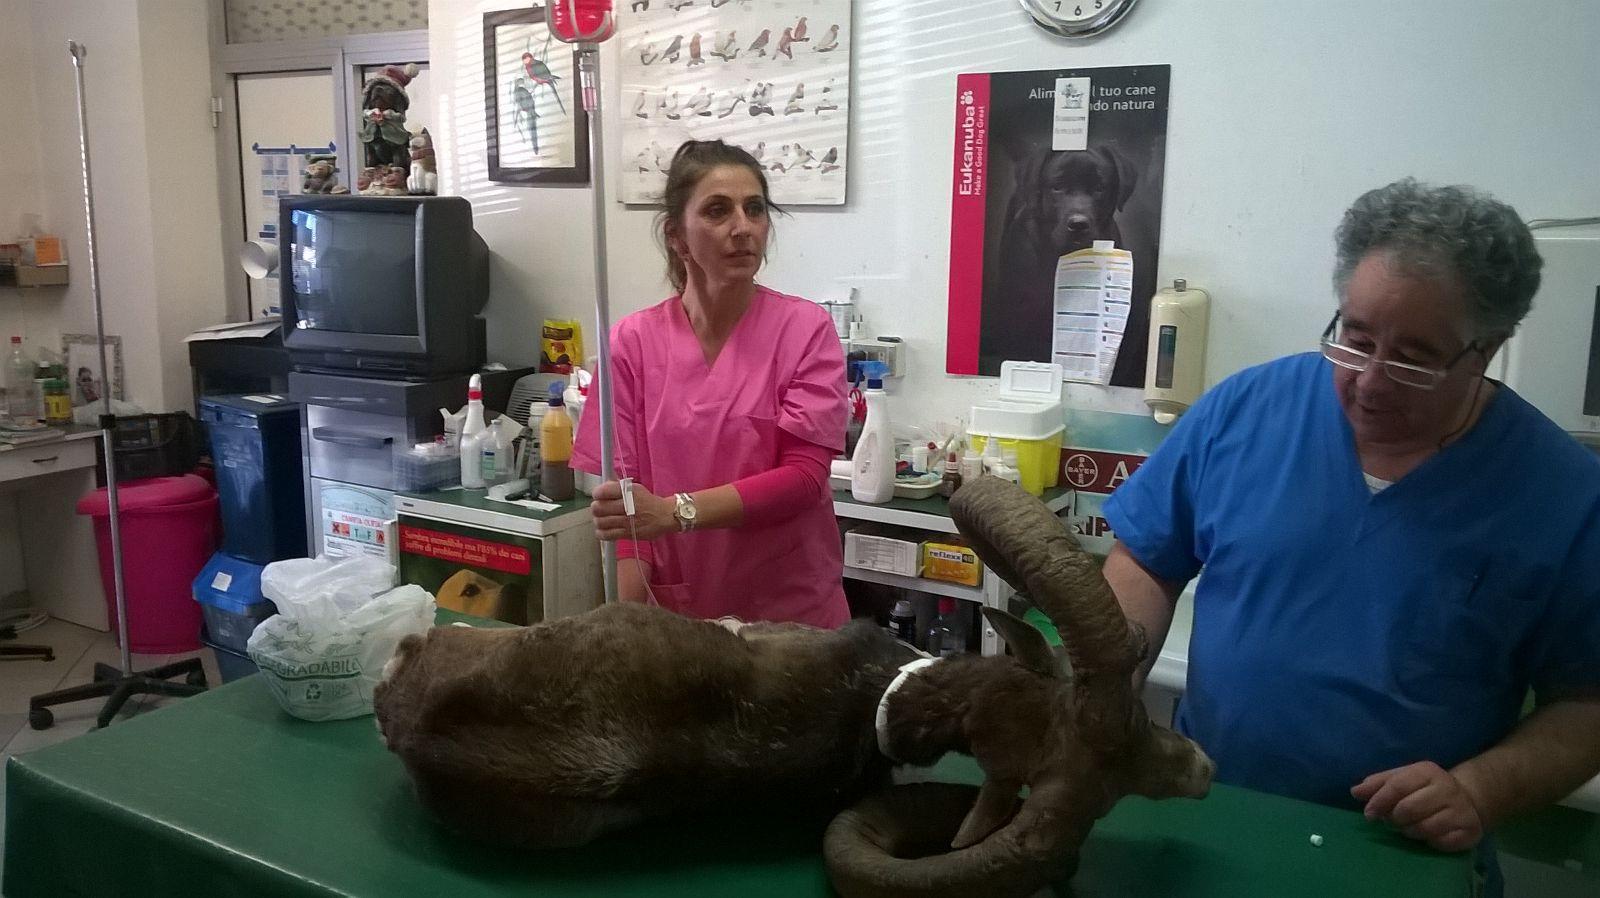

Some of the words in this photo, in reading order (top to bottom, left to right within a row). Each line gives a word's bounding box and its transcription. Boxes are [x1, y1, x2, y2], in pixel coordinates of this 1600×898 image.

[1054, 1, 1061, 12] 7
[1074, 5, 1082, 16] 6
[1094, 0, 1103, 9] 5
[1100, 86, 1122, 97] tuo
[1125, 85, 1157, 96] cane
[1112, 99, 1155, 111] natura
[976, 106, 986, 128] Great
[975, 130, 986, 145] Dog
[960, 106, 975, 195] Eukanuba
[975, 146, 984, 168] Good
[974, 175, 983, 196] Make
[1067, 466, 1096, 475] BAYER
[1078, 456, 1086, 485] BAYER
